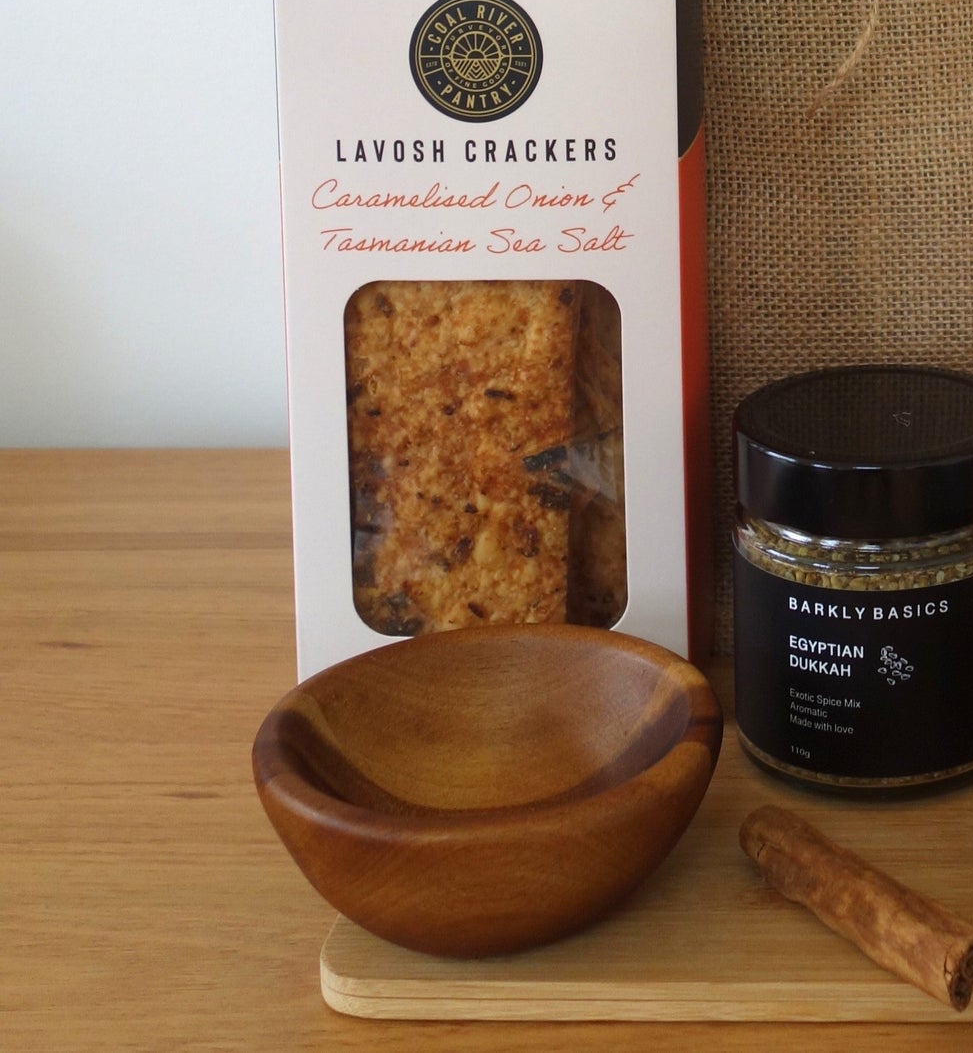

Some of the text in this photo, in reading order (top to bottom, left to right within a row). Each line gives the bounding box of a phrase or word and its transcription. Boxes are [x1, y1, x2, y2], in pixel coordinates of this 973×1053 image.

[427, 4, 524, 44] COAL RIVER
[446, 25, 507, 51] PURVEYOR
[454, 76, 477, 88] FINE
[482, 62, 508, 87] GOODS
[440, 83, 512, 109] PANTRY
[336, 138, 617, 163] LAVOSH CRACKERS
[311, 178, 499, 210] Caramelised
[504, 184, 594, 210] Onion
[320, 225, 635, 254] Tasmanian Sea Salt
[789, 596, 949, 620] BARKLY BASICS
[789, 634, 864, 659] EGYPTIAN
[789, 654, 851, 677] DUKKAH
[789, 687, 861, 708] Exotic Spice Mix
[790, 701, 828, 718] Aromatic
[789, 713, 854, 734] Made with love
[791, 745, 811, 759] 110g
